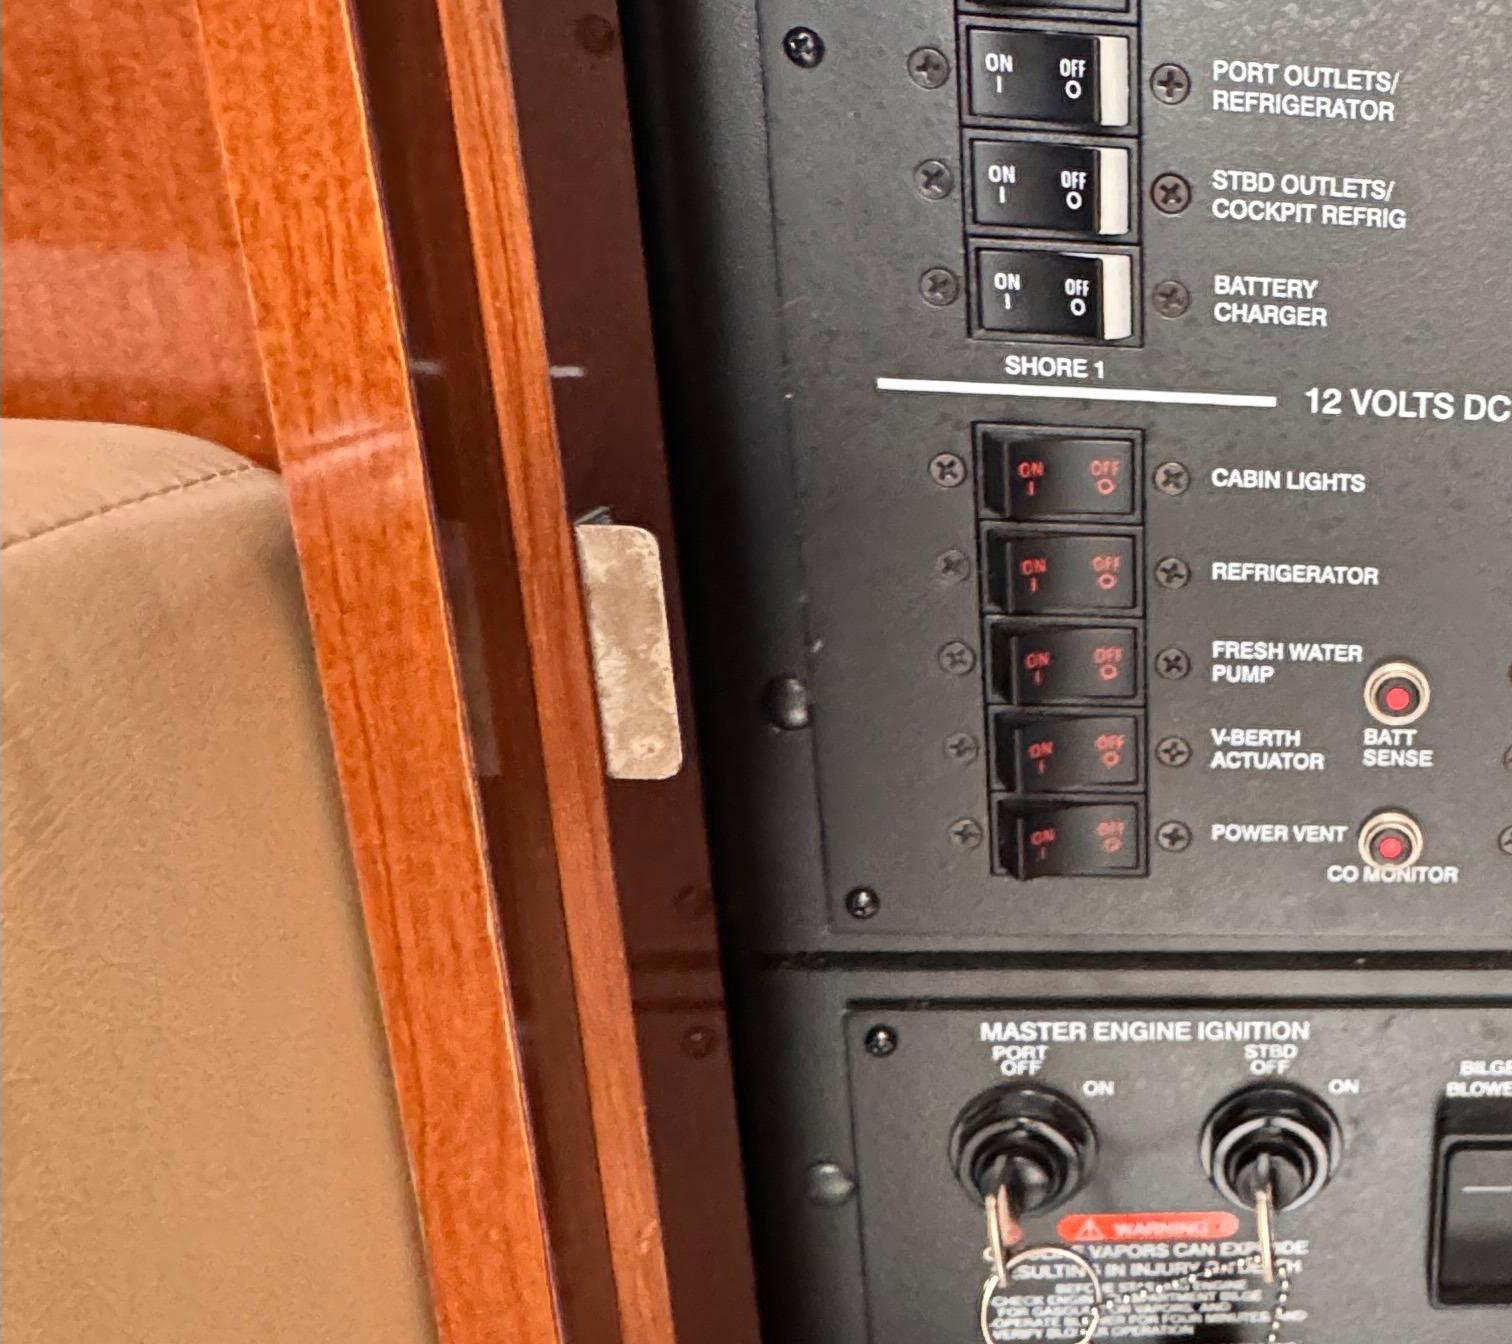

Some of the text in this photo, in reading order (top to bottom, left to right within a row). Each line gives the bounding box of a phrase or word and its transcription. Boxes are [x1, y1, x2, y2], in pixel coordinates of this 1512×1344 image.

[985, 52, 1086, 78] ON OFF
[1213, 60, 1399, 94] PORT OUTLETS/
[1213, 91, 1395, 122] REFRIGERATOR
[988, 164, 1086, 190] ON OFF
[1213, 170, 1395, 203] STBD OUTLETS/
[1212, 199, 1406, 231] COCKPIT REFRIG
[994, 272, 1090, 297] ON OFF
[1214, 275, 1320, 300] BATTERY
[1214, 304, 1328, 328] CHARGER
[1004, 355, 1105, 379] SHORE 1
[1305, 387, 1512, 422] 12 VOLTS DC
[1018, 460, 1120, 478] ON OFF
[1211, 468, 1367, 493] CABIN LIGHTS
[1021, 556, 1120, 575] ON OFF
[1211, 563, 1379, 586] REFRIGERATOR
[1026, 647, 1123, 669] ON OFF
[1211, 642, 1363, 663] FRESH WATER
[1211, 665, 1275, 684] PUMP
[1029, 735, 1125, 758] ON OFF
[1211, 728, 1301, 748] V-BERTH
[1363, 729, 1418, 747] BATT
[1211, 751, 1325, 770] ACTUATOR
[1362, 750, 1434, 768] SENSE
[1030, 821, 1126, 846] ON OFF
[1211, 824, 1348, 844] POWER VENT
[1327, 864, 1459, 884] CO MONITOR
[980, 1020, 1310, 1042] MASTER ENGINE IGNITION
[991, 1045, 1047, 1061] PORT
[1244, 1043, 1298, 1060] STBD
[1000, 1060, 1042, 1076] OFF
[1250, 1059, 1290, 1075] OFF
[1082, 1080, 1115, 1097] ON
[1328, 1079, 1360, 1095] ON
[1087, 1242, 1170, 1260] VAPORS
[1172, 1241, 1216, 1258] CAN
